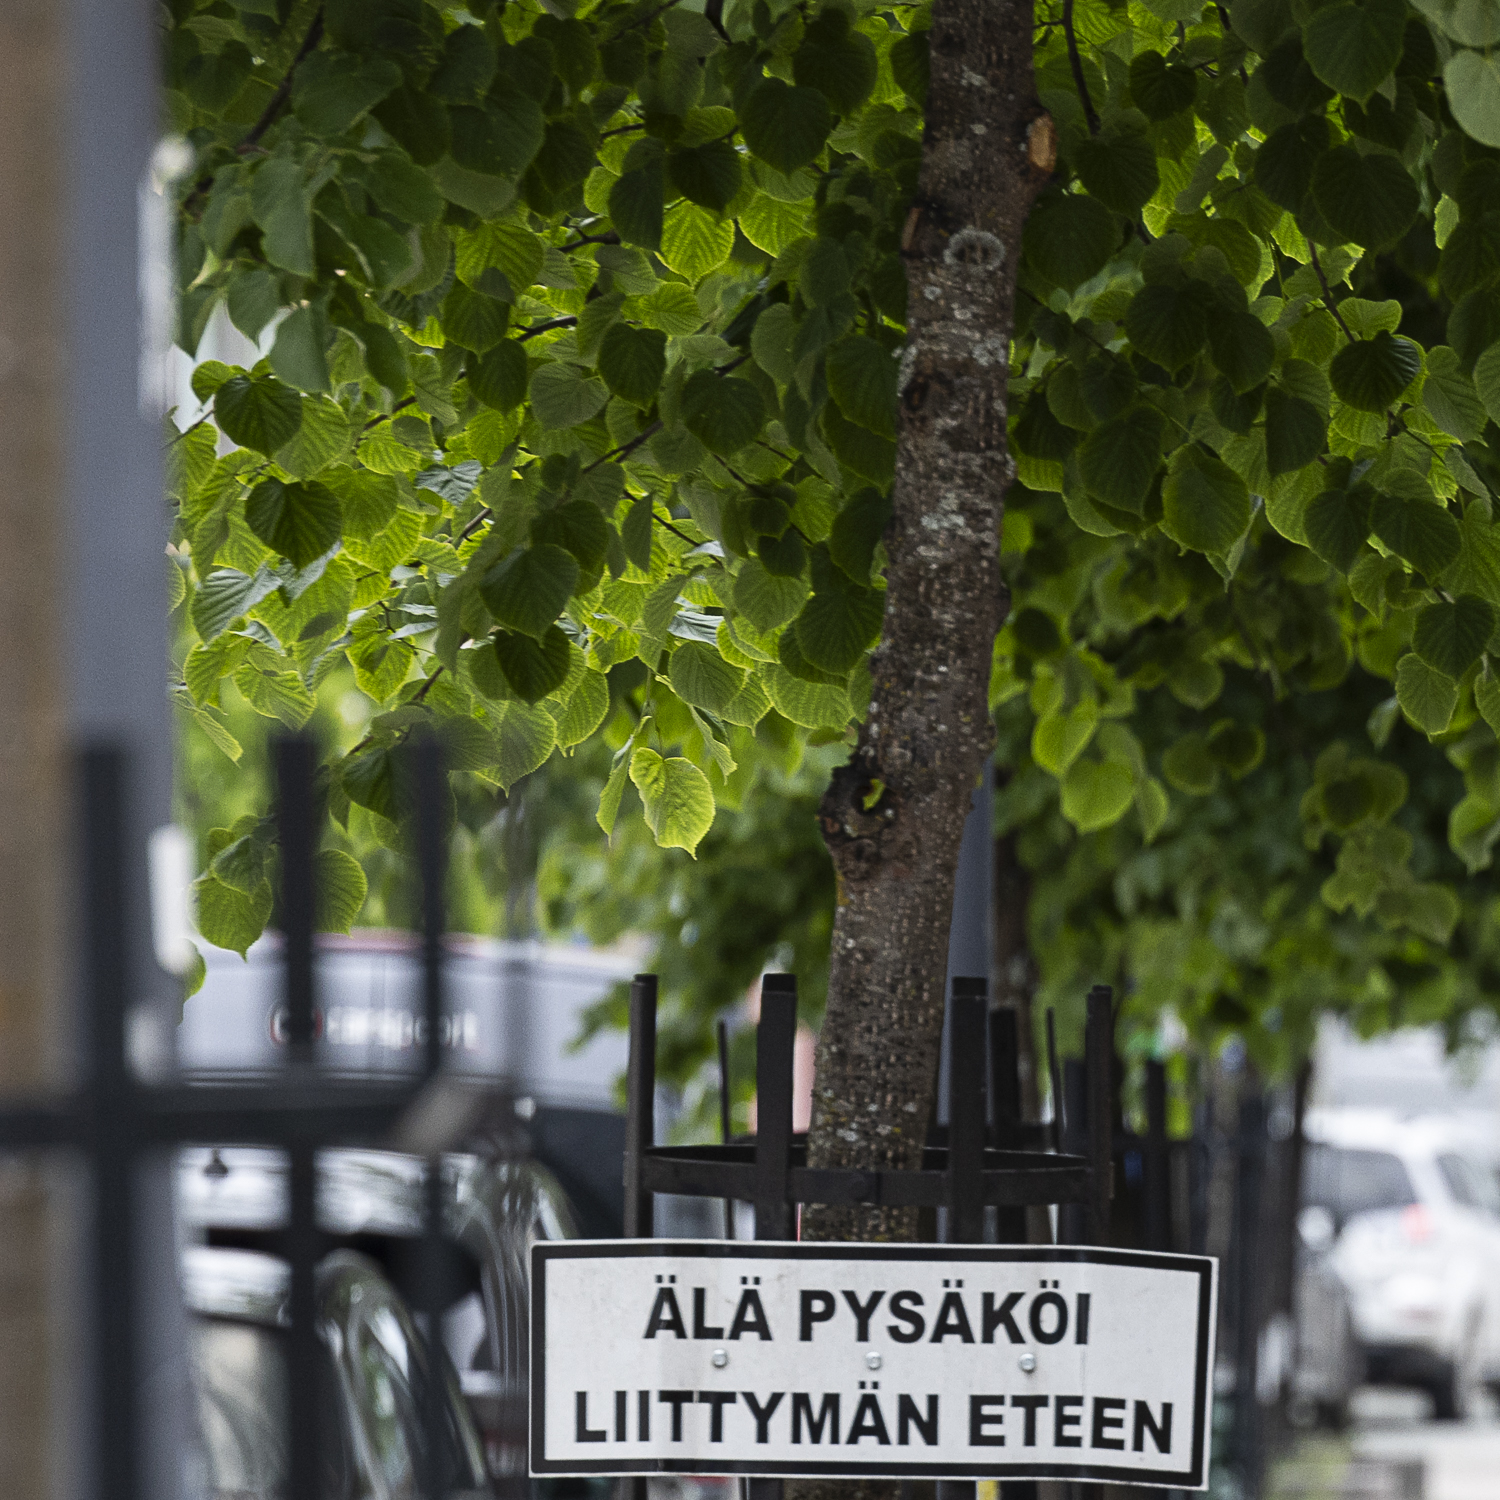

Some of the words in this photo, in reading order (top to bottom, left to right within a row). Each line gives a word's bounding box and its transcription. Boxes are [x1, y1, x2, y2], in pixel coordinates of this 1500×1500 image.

[643, 1274, 774, 1341] ÄLÄ
[799, 1278, 1091, 1345] PYSÄKÖI
[576, 1380, 939, 1446] LIITTYMÄN
[968, 1394, 1174, 1455] ETEEN
